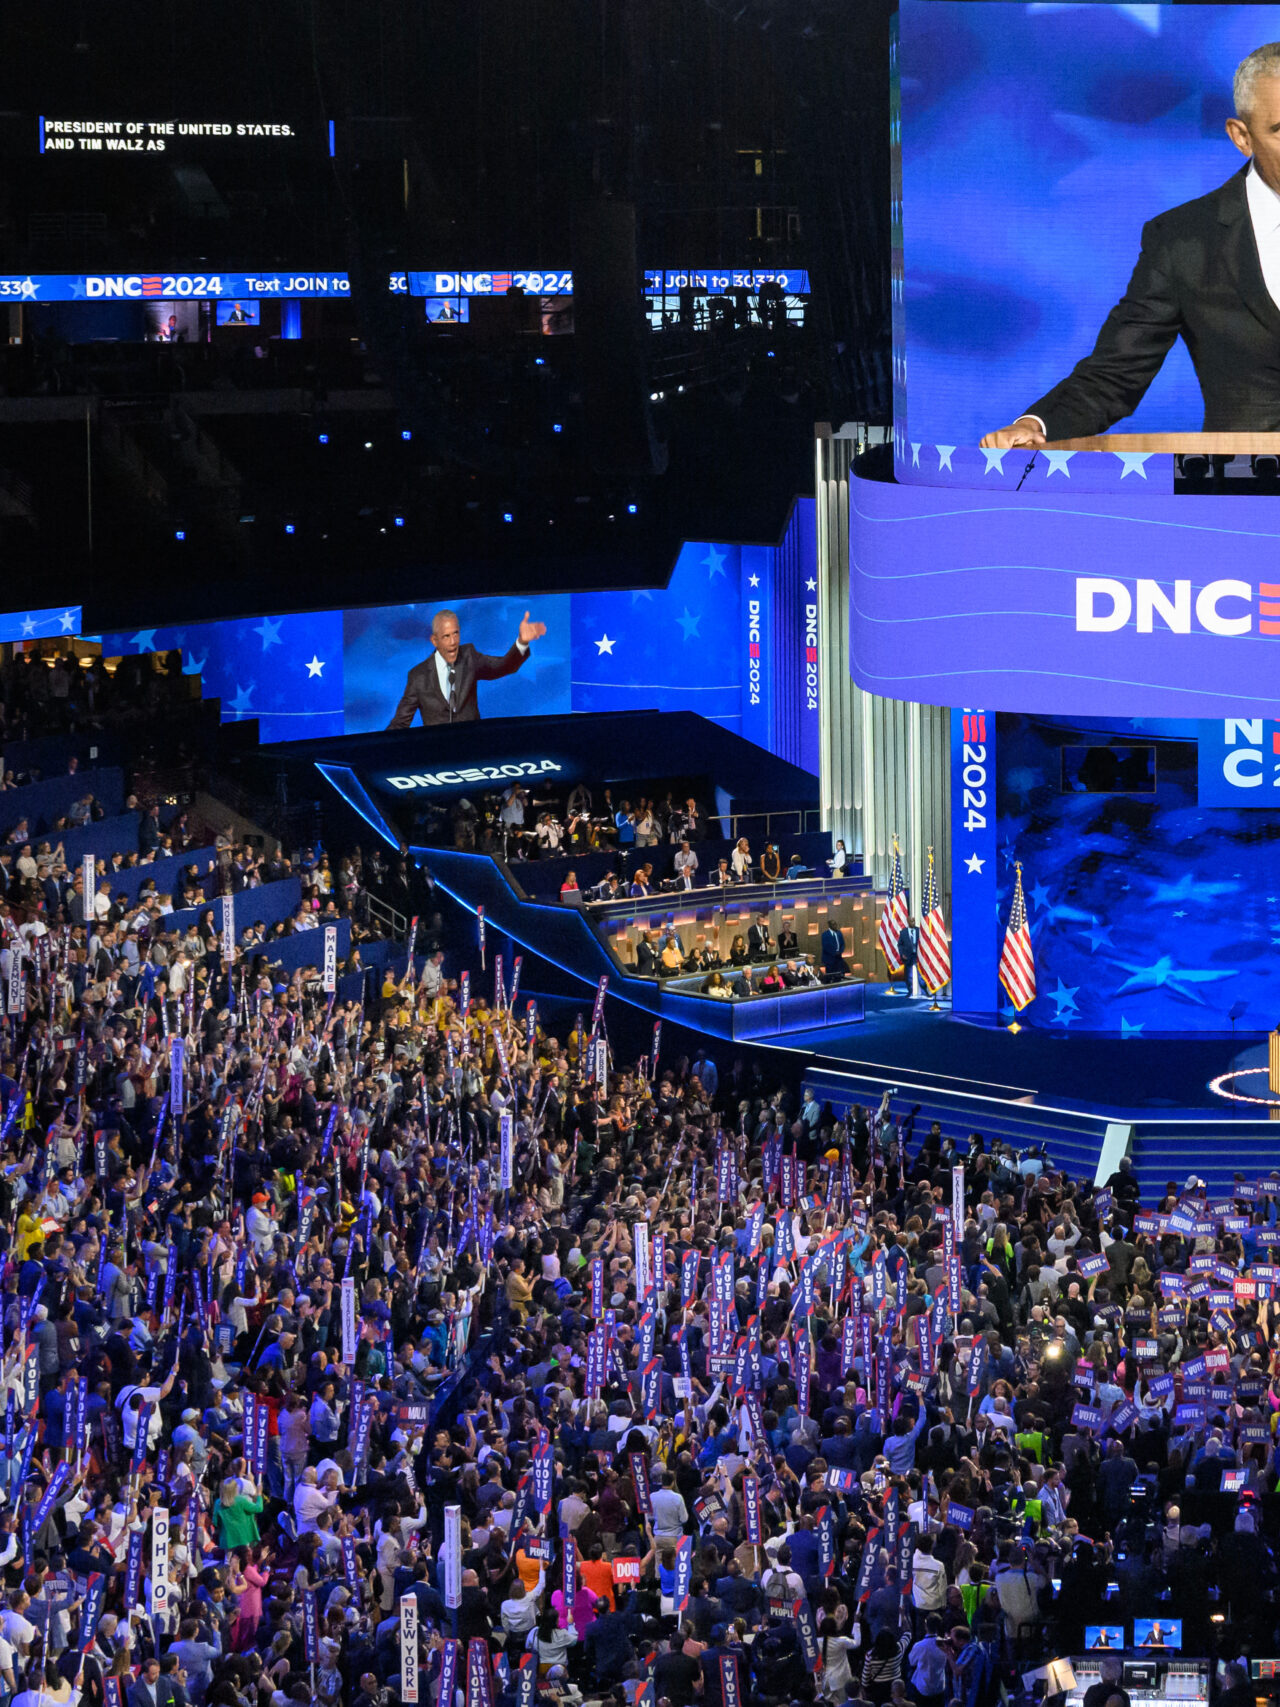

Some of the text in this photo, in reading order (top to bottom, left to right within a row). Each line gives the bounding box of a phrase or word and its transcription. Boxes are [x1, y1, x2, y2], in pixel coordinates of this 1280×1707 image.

[45, 121, 295, 136] PRESIDENT OF THE UNITED STATES.
[45, 139, 165, 151] AND TIM WALZ AS
[86, 278, 142, 297] DNC
[163, 277, 222, 295] 2024
[245, 278, 280, 291] Text
[284, 277, 328, 291] JOIN
[332, 278, 350, 291] to
[436, 274, 492, 293] DNC
[513, 274, 573, 292] 2024
[665, 275, 707, 288] JOIN
[712, 275, 729, 287] to
[1075, 577, 1251, 635] DNC
[749, 600, 760, 705] DNC 2024
[806, 603, 817, 710] DNC 2024
[386, 760, 562, 790] DNC 2024
[962, 744, 986, 832] 2024
[326, 935, 335, 983] MAINE
[11, 950, 20, 1004] VERMONT
[1263, 1182, 1278, 1191] VOTE
[300, 1207, 314, 1243] VOTE
[750, 1213, 761, 1246] VOTE
[1139, 1220, 1155, 1230] VOTE
[1229, 1220, 1244, 1229] VOTE
[1262, 1232, 1278, 1241] VOTE
[1086, 1259, 1104, 1272] VOTE
[1196, 1258, 1212, 1268] VOTE
[724, 1261, 732, 1300] VOTE
[951, 1266, 959, 1299] VOTE
[1164, 1277, 1180, 1286] VOTE
[1214, 1295, 1230, 1304] VOTE
[971, 1348, 982, 1385] VOTE
[1136, 1348, 1157, 1356] FUTURE
[28, 1358, 37, 1400] VOTE
[906, 1379, 928, 1392] PEOPLE
[1078, 1410, 1096, 1422] VOTE
[1181, 1409, 1200, 1418] VOTE
[258, 1420, 267, 1459] VOTE
[355, 1412, 368, 1453] VOTE
[541, 1458, 550, 1500] VOTE
[830, 1471, 853, 1489] USA
[747, 1490, 756, 1529] VOTE
[887, 1500, 896, 1543] VOTE
[951, 1508, 968, 1522] VOTE
[530, 1547, 549, 1559] PEOPLE
[820, 1521, 830, 1564] VOTE
[128, 1547, 139, 1591] VOTE
[155, 1522, 167, 1599] OHIO
[565, 1554, 573, 1594] VOTE
[677, 1551, 688, 1596] VOTE
[83, 1589, 98, 1638] VOTE
[404, 1608, 416, 1688] NEW YORK
